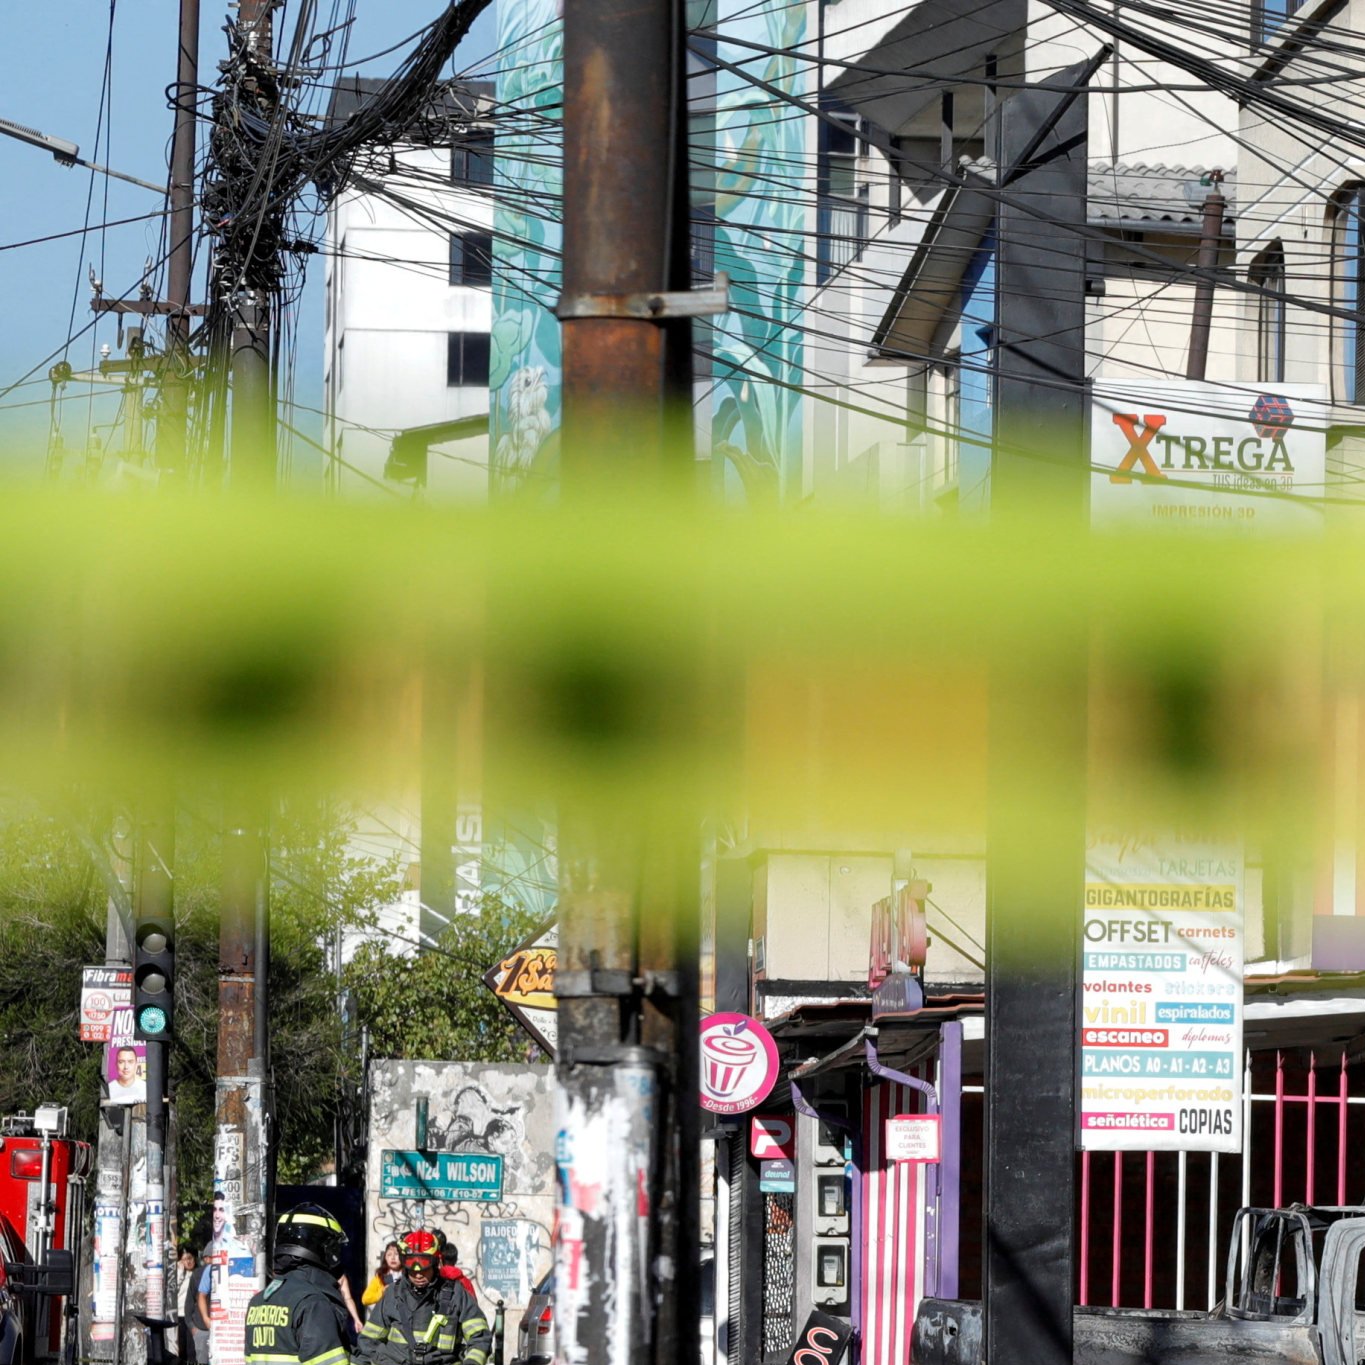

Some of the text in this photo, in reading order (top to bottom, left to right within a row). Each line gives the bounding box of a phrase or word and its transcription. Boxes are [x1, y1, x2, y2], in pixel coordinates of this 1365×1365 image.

[1109, 413, 1295, 484] XTREGA
[1158, 857, 1236, 877] TARJETAS
[1086, 887, 1234, 908] GIGANTOGRAFÍAS
[1084, 919, 1236, 943] OFFSET carnets
[1088, 949, 1234, 975] EMPASTADOS carteles
[1083, 981, 1236, 996] volantes stickers
[1085, 1000, 1231, 1025] vinil espiralados
[1086, 1027, 1233, 1048] escaneo diplomas
[1085, 1055, 1230, 1074] PLANOS A0 A1 A2 A3
[1082, 1084, 1234, 1105] microperforado
[1088, 1109, 1233, 1135] señalética COPIAS
[417, 1160, 496, 1183] N24 WILSON
[247, 1306, 289, 1326] BOMBEROS
